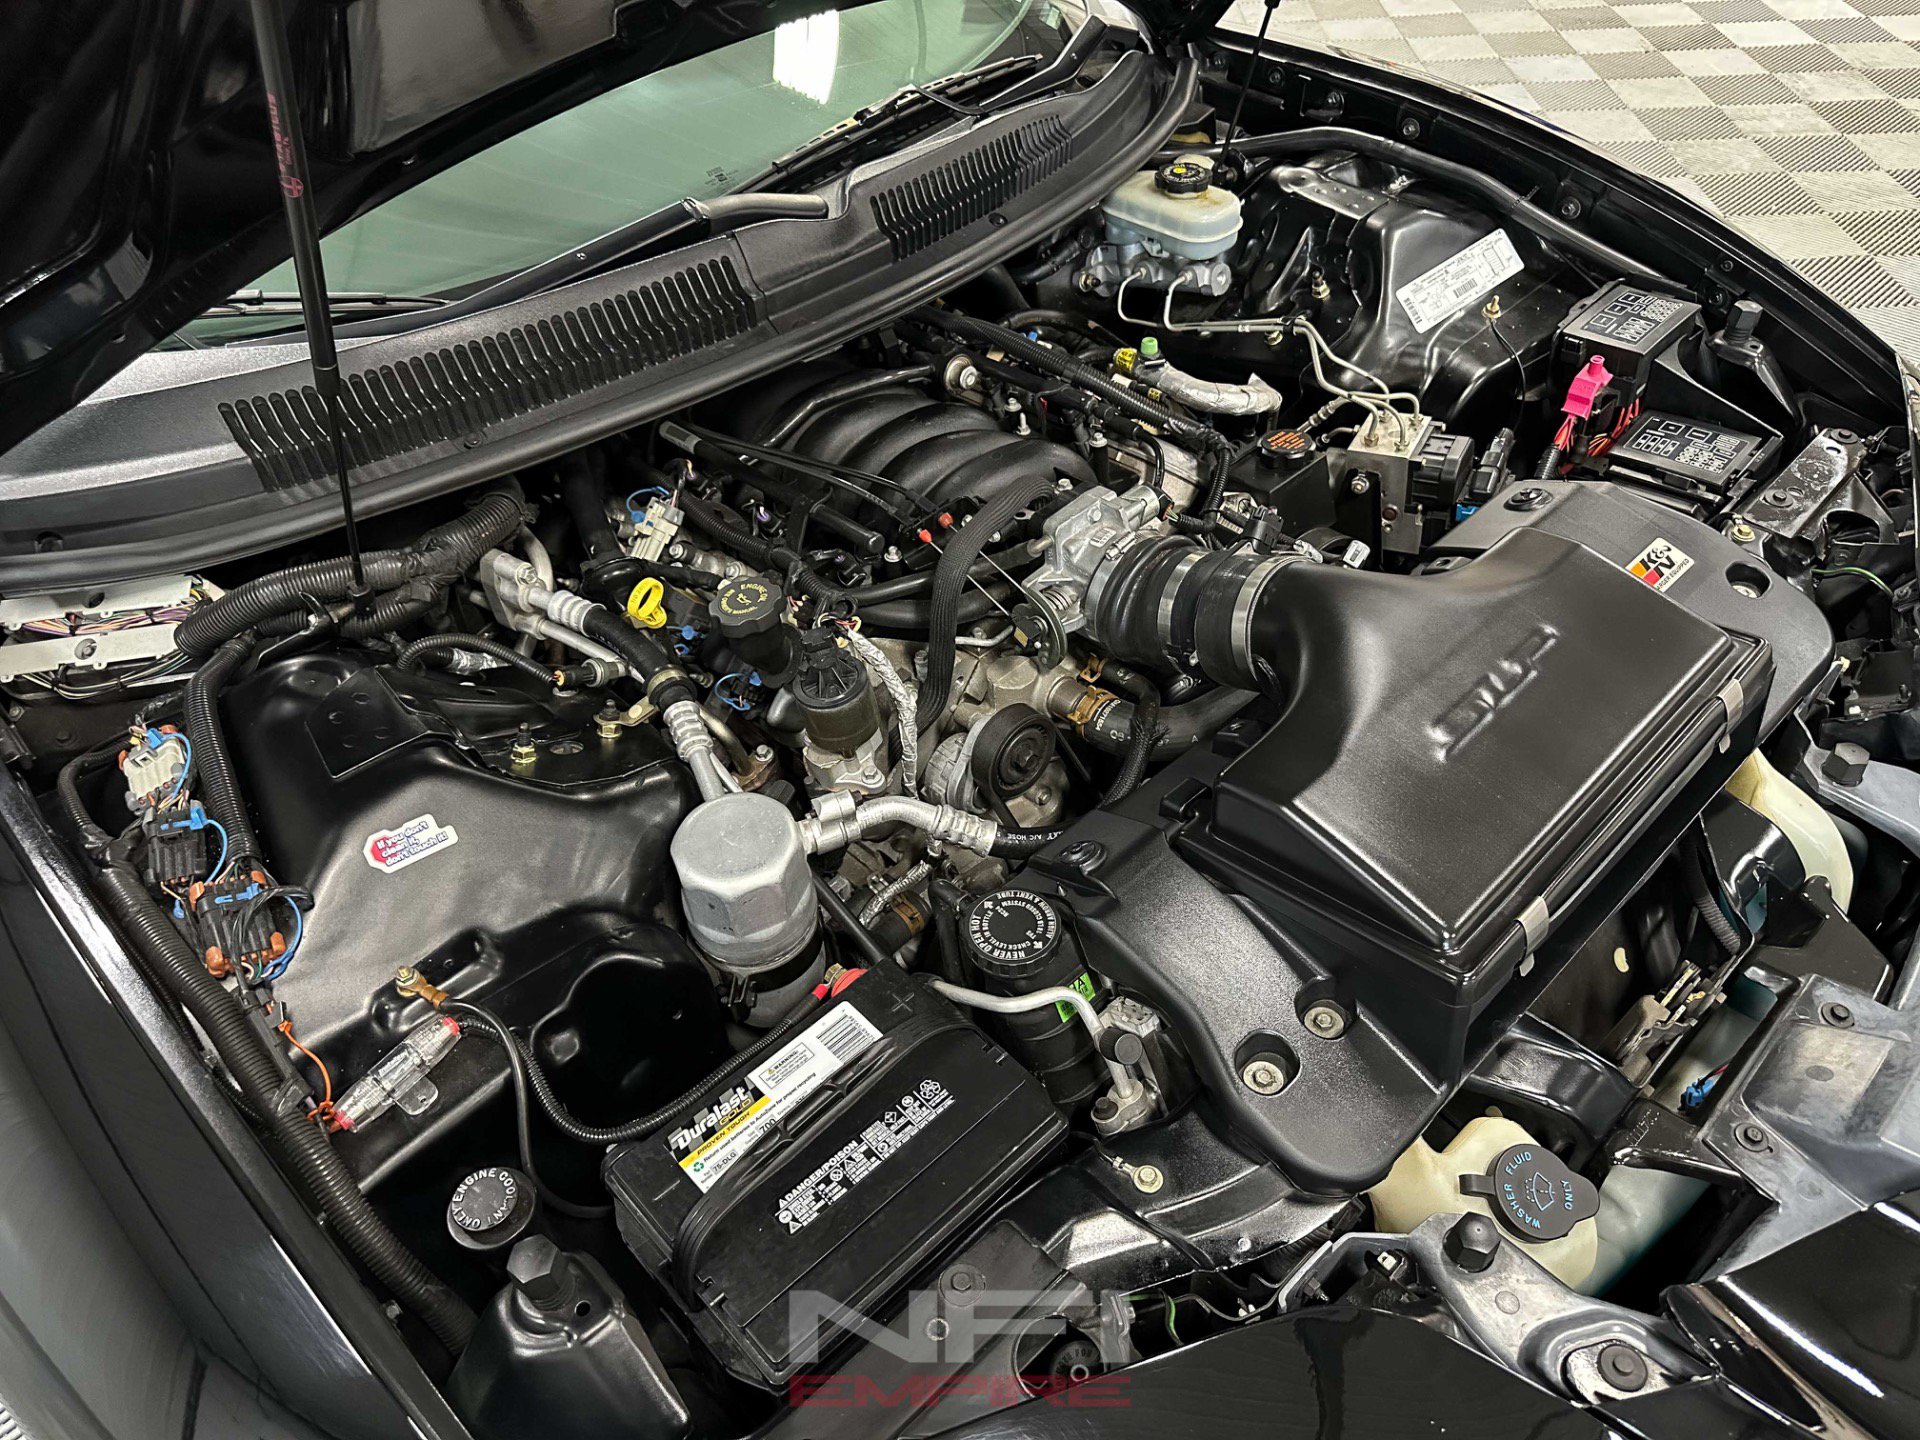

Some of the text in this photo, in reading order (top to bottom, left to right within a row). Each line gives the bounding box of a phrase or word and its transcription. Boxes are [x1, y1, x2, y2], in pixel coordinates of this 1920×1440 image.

[1639, 545, 1675, 578] K&N
[741, 583, 767, 593] ENGINE
[386, 832, 404, 847] you
[404, 820, 429, 837] don't
[381, 841, 408, 858] clean
[385, 847, 410, 867] don't
[409, 838, 438, 855] touch
[997, 890, 1015, 899] TUBE
[1016, 890, 1033, 900] VENT
[1037, 901, 1055, 920] ARROW
[971, 914, 1025, 959] NEVER OPEN HOT
[989, 936, 1008, 949] LEVEL
[1008, 941, 1031, 950] CHECK
[671, 1086, 749, 1150] Duralast
[703, 1148, 720, 1163] Return
[719, 1141, 730, 1151] used
[730, 1126, 751, 1143] batteries
[755, 1103, 777, 1123] AutoZone
[783, 1087, 798, 1102] proper
[796, 1072, 817, 1089] recycling
[720, 1098, 752, 1126] GOLD
[760, 1117, 777, 1135] 700
[697, 1111, 750, 1156] PROVEN TOUGH
[713, 1150, 737, 1172] 75-DLG
[785, 1140, 858, 1202] DANGER/POISON
[451, 1168, 516, 1229] ONLY ENGINE COOLANT
[1503, 1151, 1541, 1229] WASHER FLUID
[1561, 1180, 1574, 1211] ONLY
